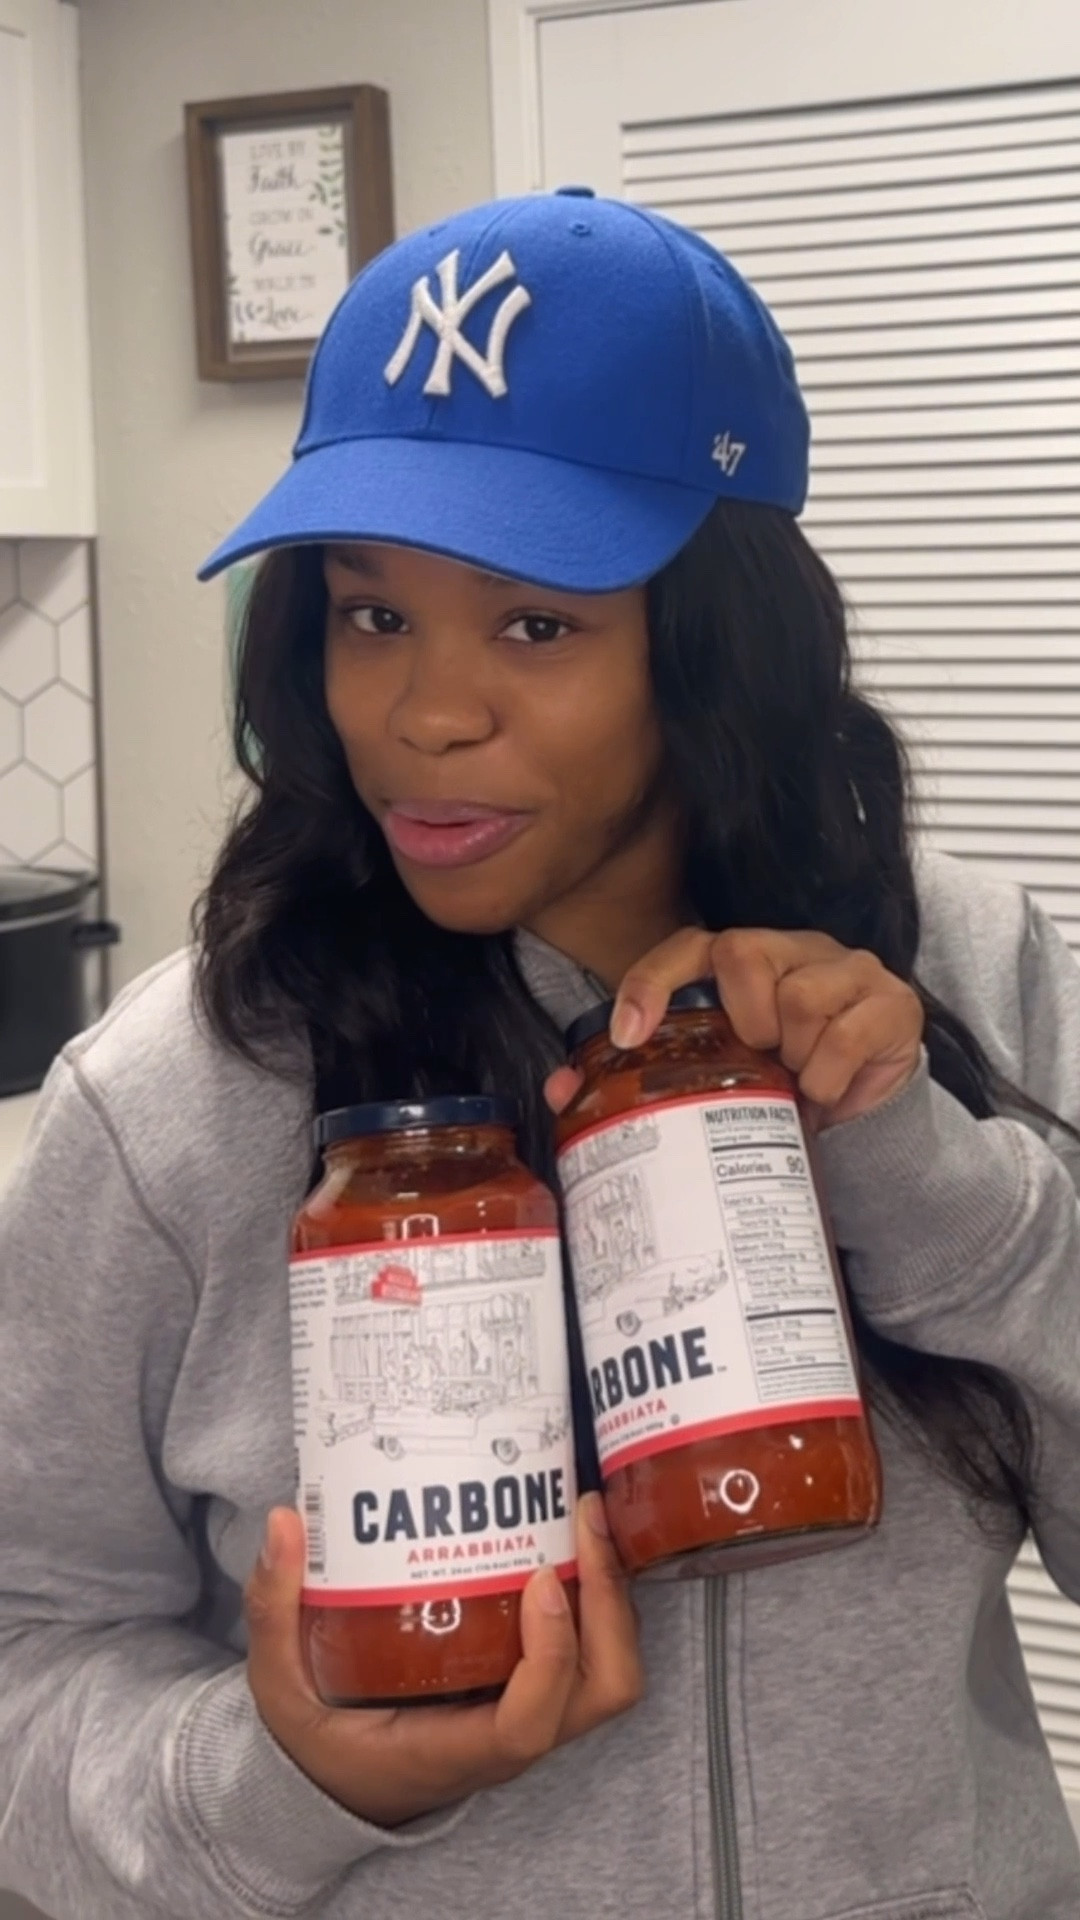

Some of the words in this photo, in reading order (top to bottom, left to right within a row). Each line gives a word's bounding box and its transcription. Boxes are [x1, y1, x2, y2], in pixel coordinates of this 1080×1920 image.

[716, 1161, 773, 1178] Calories
[353, 1468, 566, 1545] CARBONE
[407, 1534, 536, 1565] ARRABBIATA
